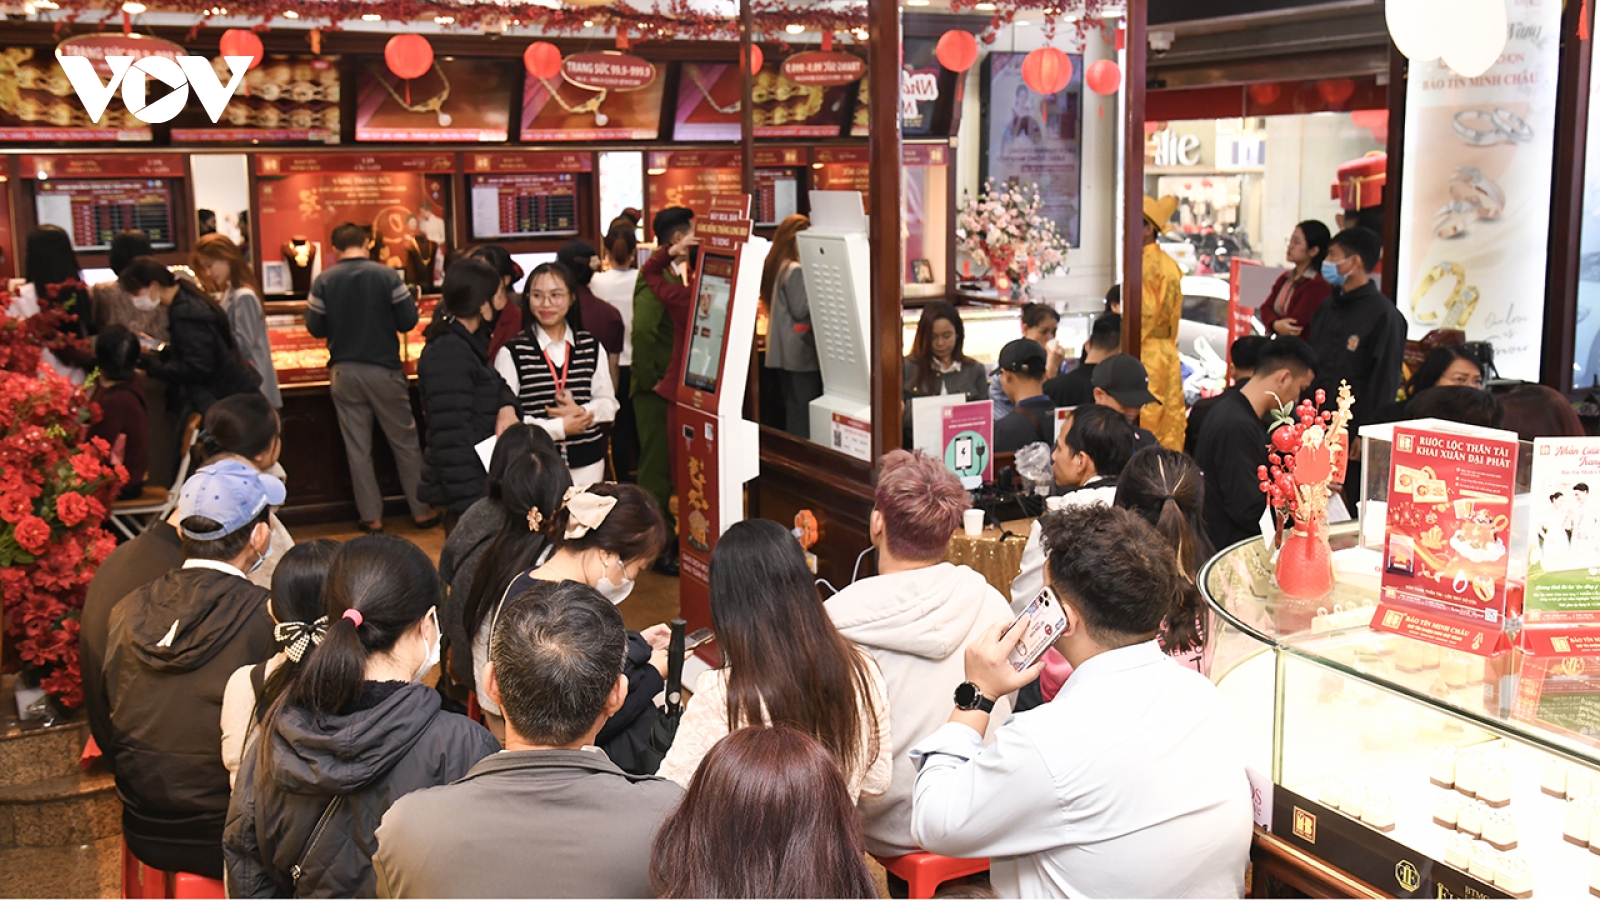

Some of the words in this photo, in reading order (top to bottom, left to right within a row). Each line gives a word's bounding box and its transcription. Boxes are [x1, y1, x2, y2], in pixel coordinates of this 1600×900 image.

[1469, 74, 1501, 88] MINH
[1416, 446, 1439, 457] KHAI
[1446, 440, 1465, 451] LỘC
[1494, 446, 1509, 458] TÀI
